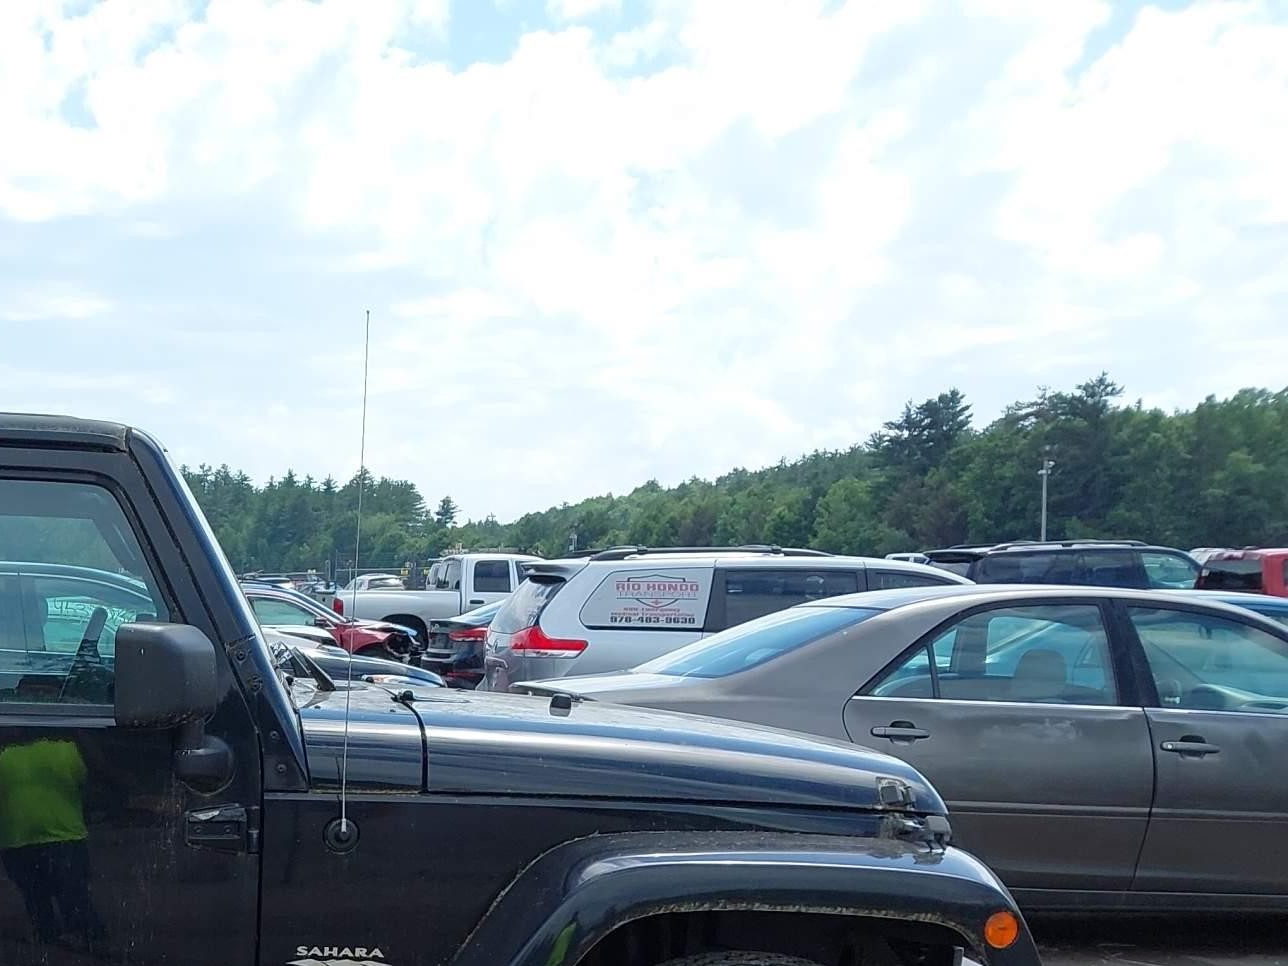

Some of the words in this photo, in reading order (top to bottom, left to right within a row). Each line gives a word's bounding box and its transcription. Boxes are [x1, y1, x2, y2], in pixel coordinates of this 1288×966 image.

[616, 583, 641, 592] RIO
[647, 583, 699, 592] HONDO
[296, 945, 385, 958] SAHARA
